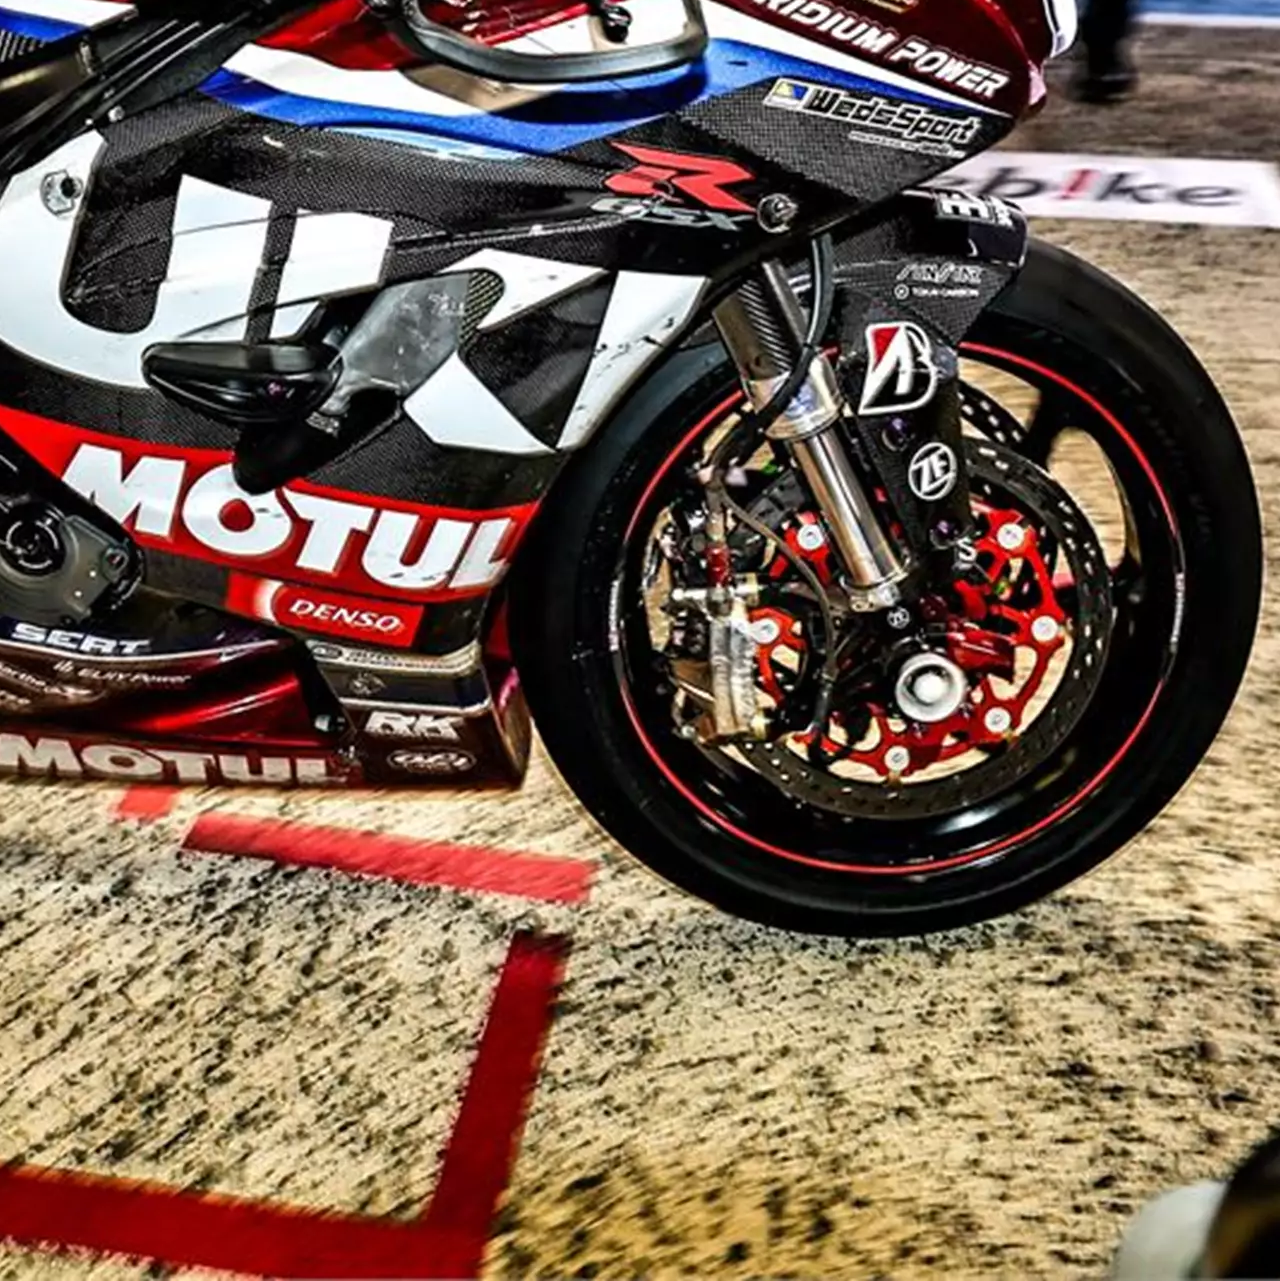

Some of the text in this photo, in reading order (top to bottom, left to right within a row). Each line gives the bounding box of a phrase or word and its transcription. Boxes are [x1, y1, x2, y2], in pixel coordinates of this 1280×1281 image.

[887, 39, 1011, 98] POWER
[805, 87, 981, 146] WedsSport
[60, 443, 515, 593] MOTUL
[287, 596, 402, 636] DENSO
